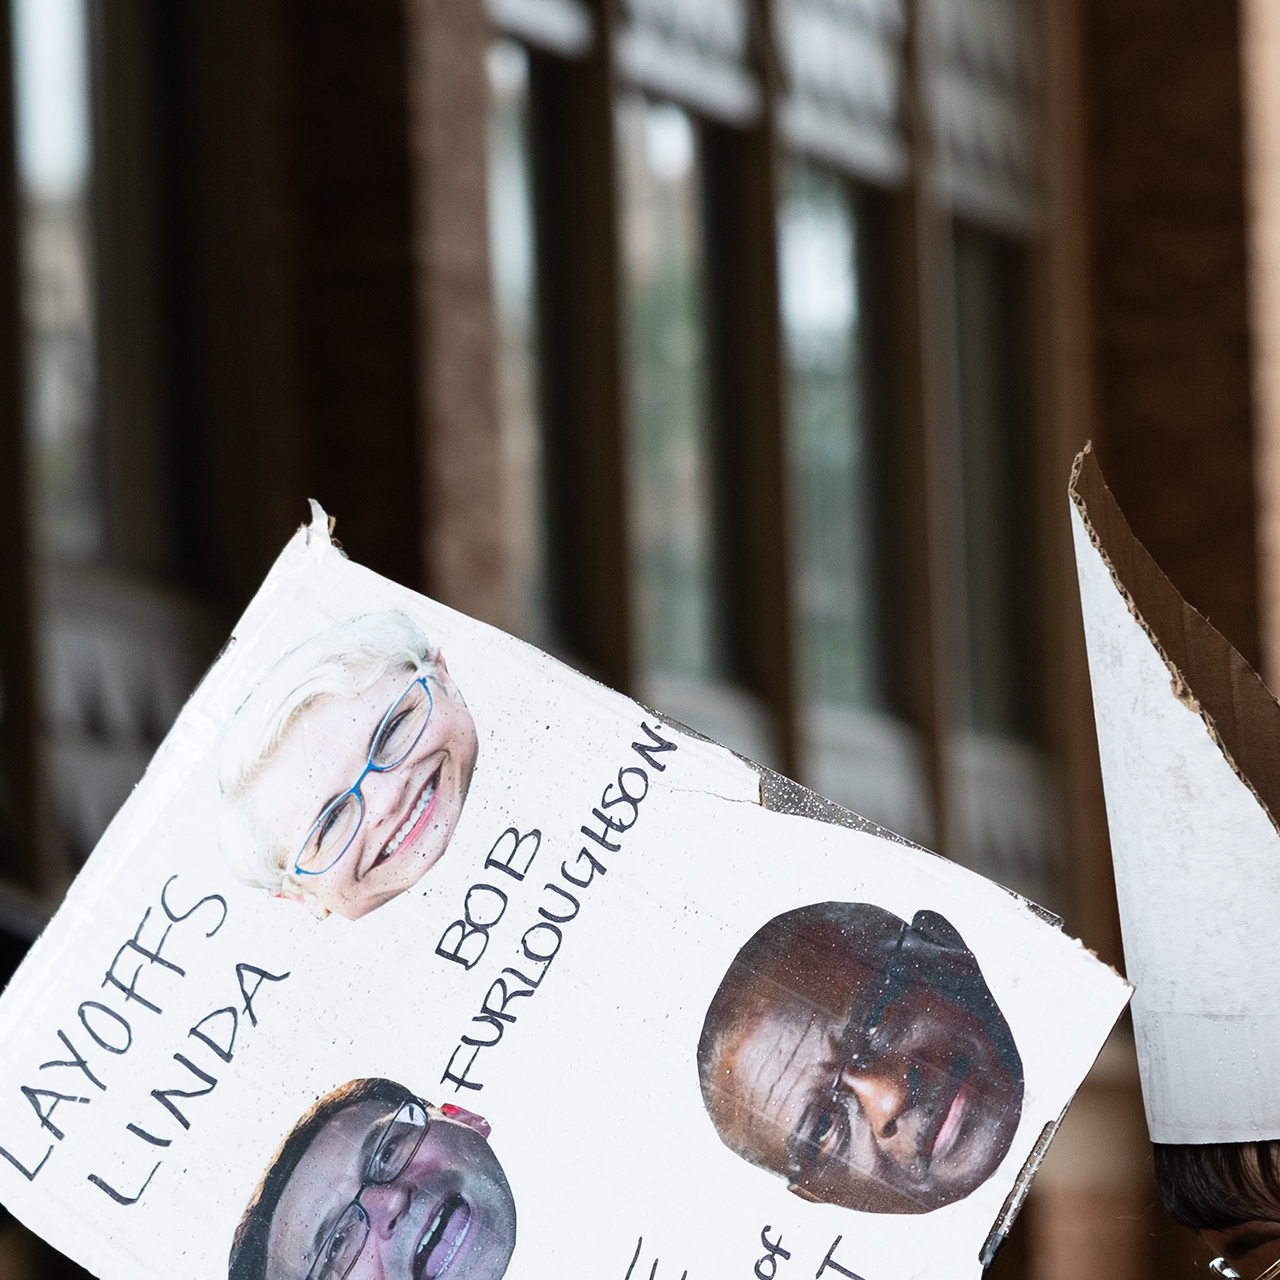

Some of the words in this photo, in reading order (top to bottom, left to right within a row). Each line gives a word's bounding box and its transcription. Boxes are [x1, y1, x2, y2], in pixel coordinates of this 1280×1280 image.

[434, 826, 542, 971] BOB
[439, 721, 678, 1093] FURLOUGHSON
[87, 962, 291, 1206] LINDA
